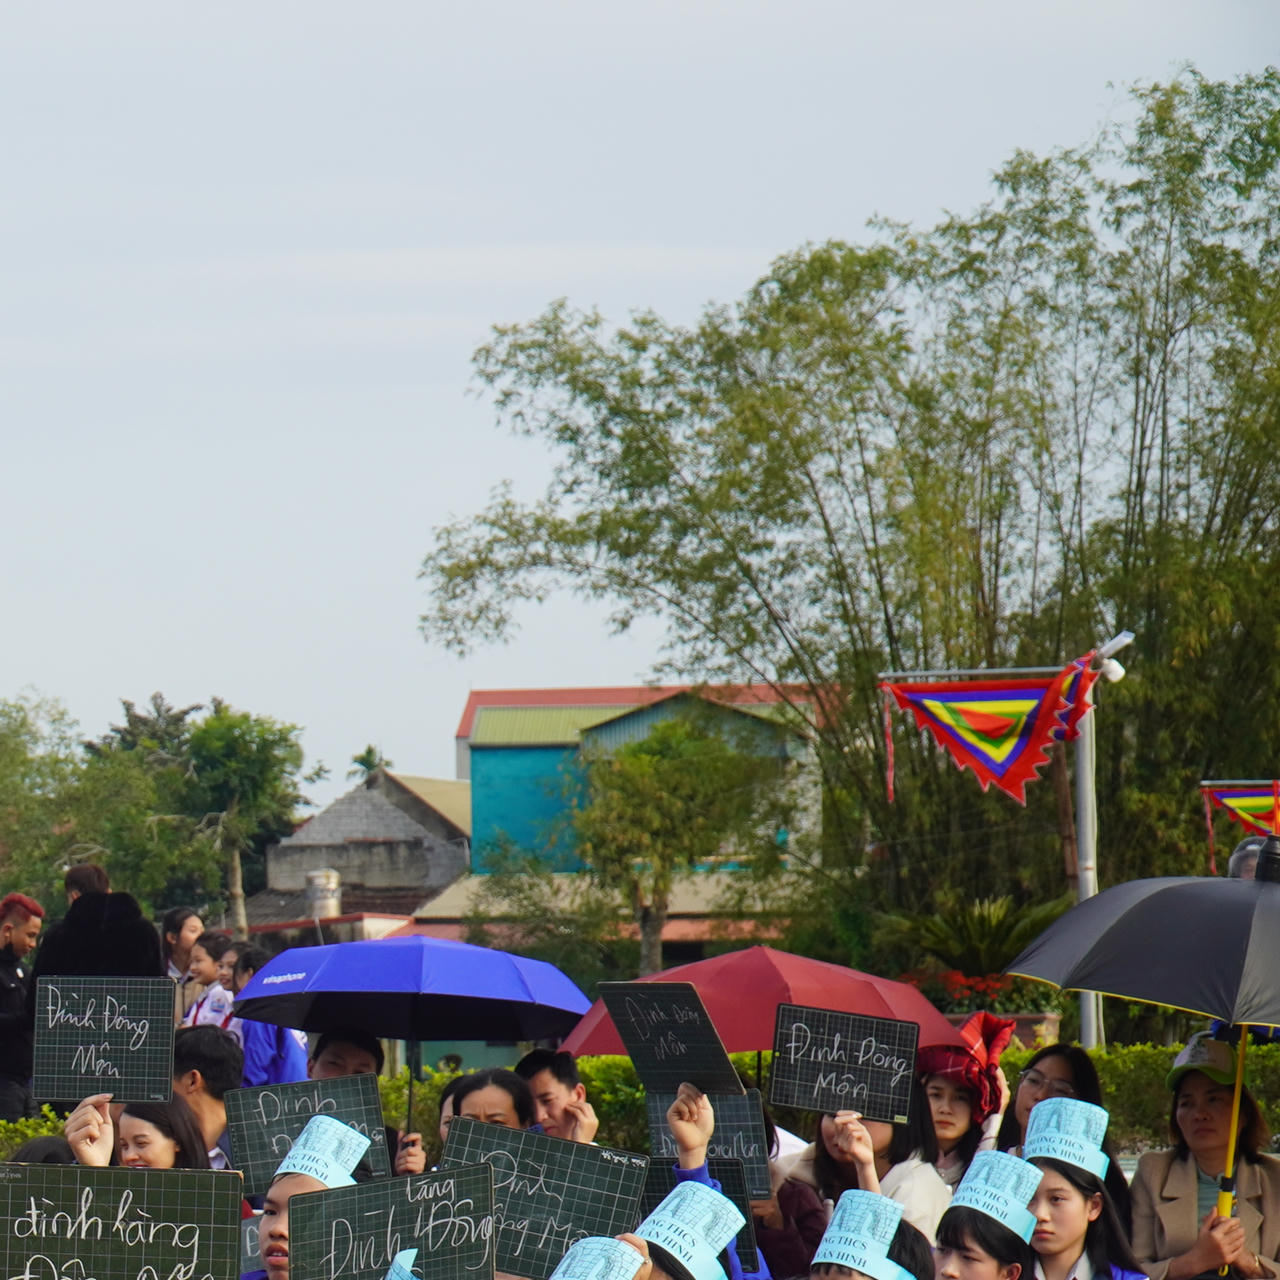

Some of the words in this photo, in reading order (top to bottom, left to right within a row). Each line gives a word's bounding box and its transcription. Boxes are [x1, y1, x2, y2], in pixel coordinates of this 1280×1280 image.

[46, 984, 96, 1029] Đình
[103, 995, 150, 1051] Đông
[71, 1041, 121, 1079] Môn
[813, 1071, 868, 1100] Môn
